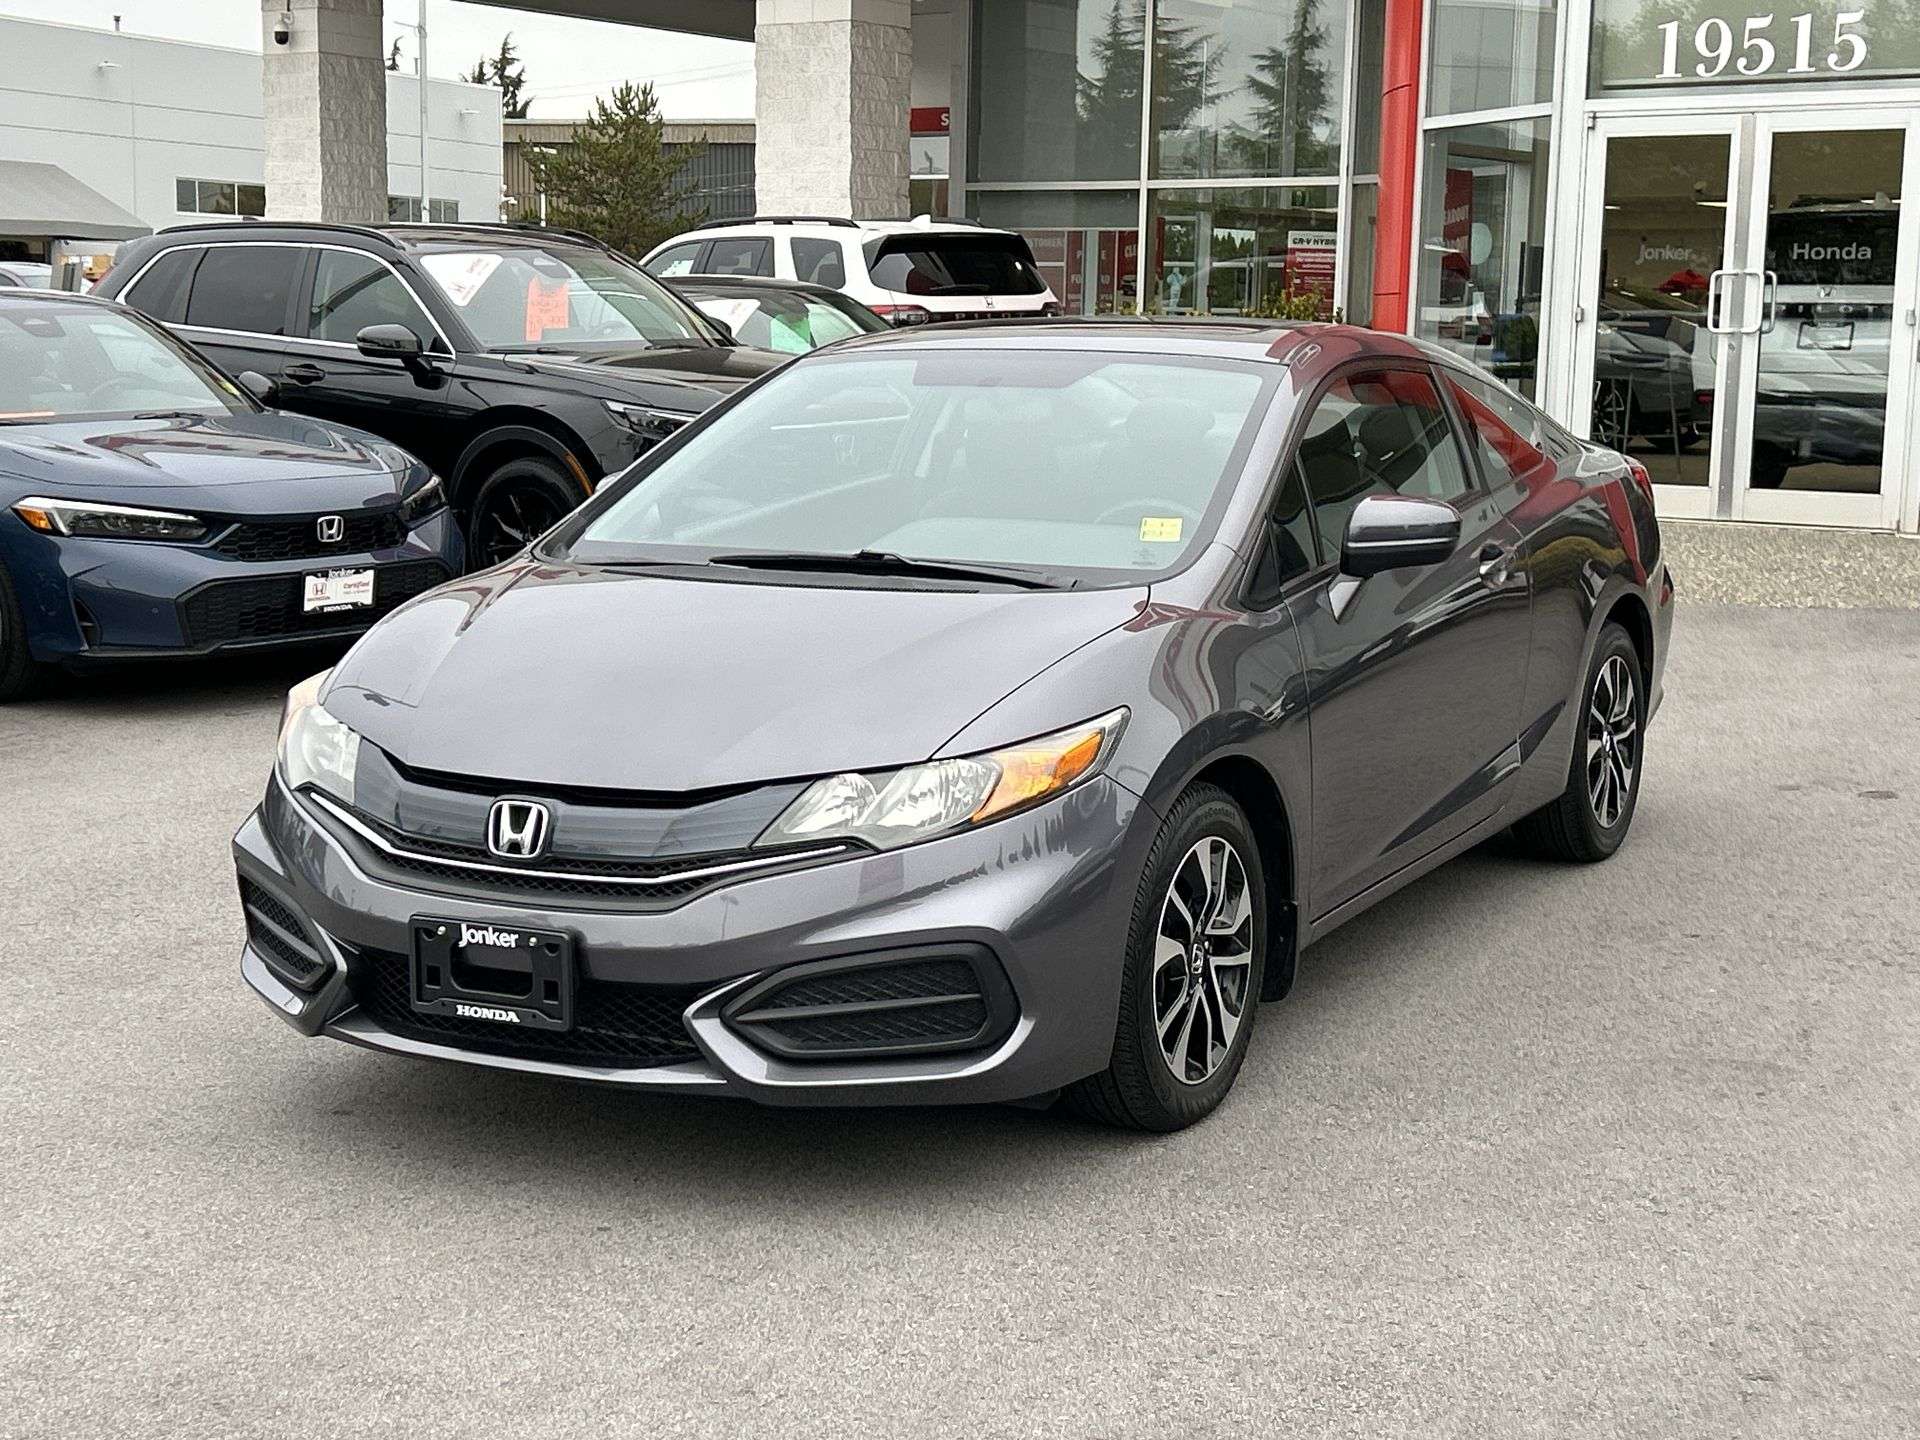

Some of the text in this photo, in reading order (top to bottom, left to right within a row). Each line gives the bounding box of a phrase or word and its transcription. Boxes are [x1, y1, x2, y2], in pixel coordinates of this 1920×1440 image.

[1655, 8, 1868, 79] 19515
[1792, 242, 1873, 261] Honda
[458, 923, 519, 948] Jonker
[456, 1004, 520, 1023] HONDA
